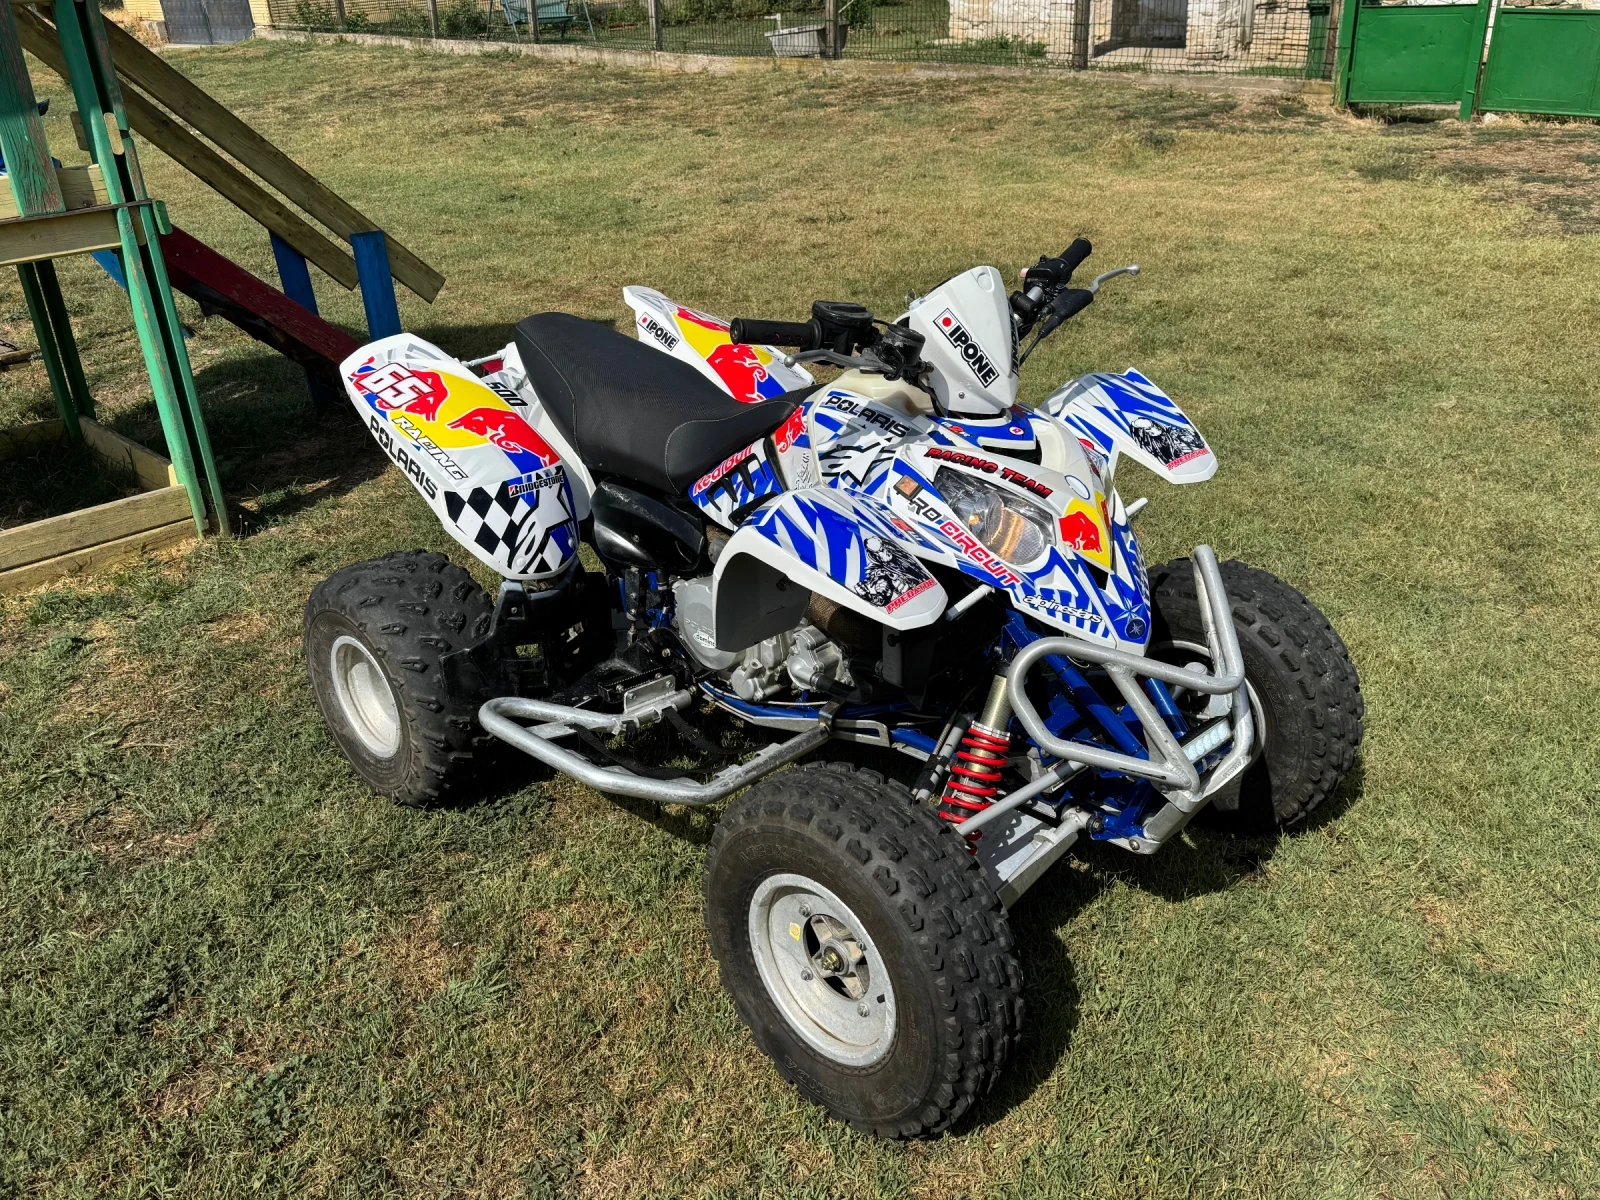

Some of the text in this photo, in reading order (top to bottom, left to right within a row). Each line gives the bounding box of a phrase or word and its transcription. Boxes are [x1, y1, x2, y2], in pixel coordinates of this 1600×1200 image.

[646, 319, 678, 348] IPONE
[948, 325, 997, 386] IPONE
[358, 363, 435, 408] 65
[488, 381, 529, 407] 500
[825, 396, 911, 438] POLARIS
[370, 415, 438, 500] POLARIS
[392, 416, 469, 480] RACING
[693, 444, 752, 496] Red Bull
[509, 475, 565, 497] BRIDGESTONE
[924, 448, 1054, 499] RACING TEAM
[909, 495, 942, 522] RO
[940, 521, 1023, 586] CIRCUIT
[885, 578, 937, 614] PREDATOR
[1024, 594, 1103, 624] alpinestars
